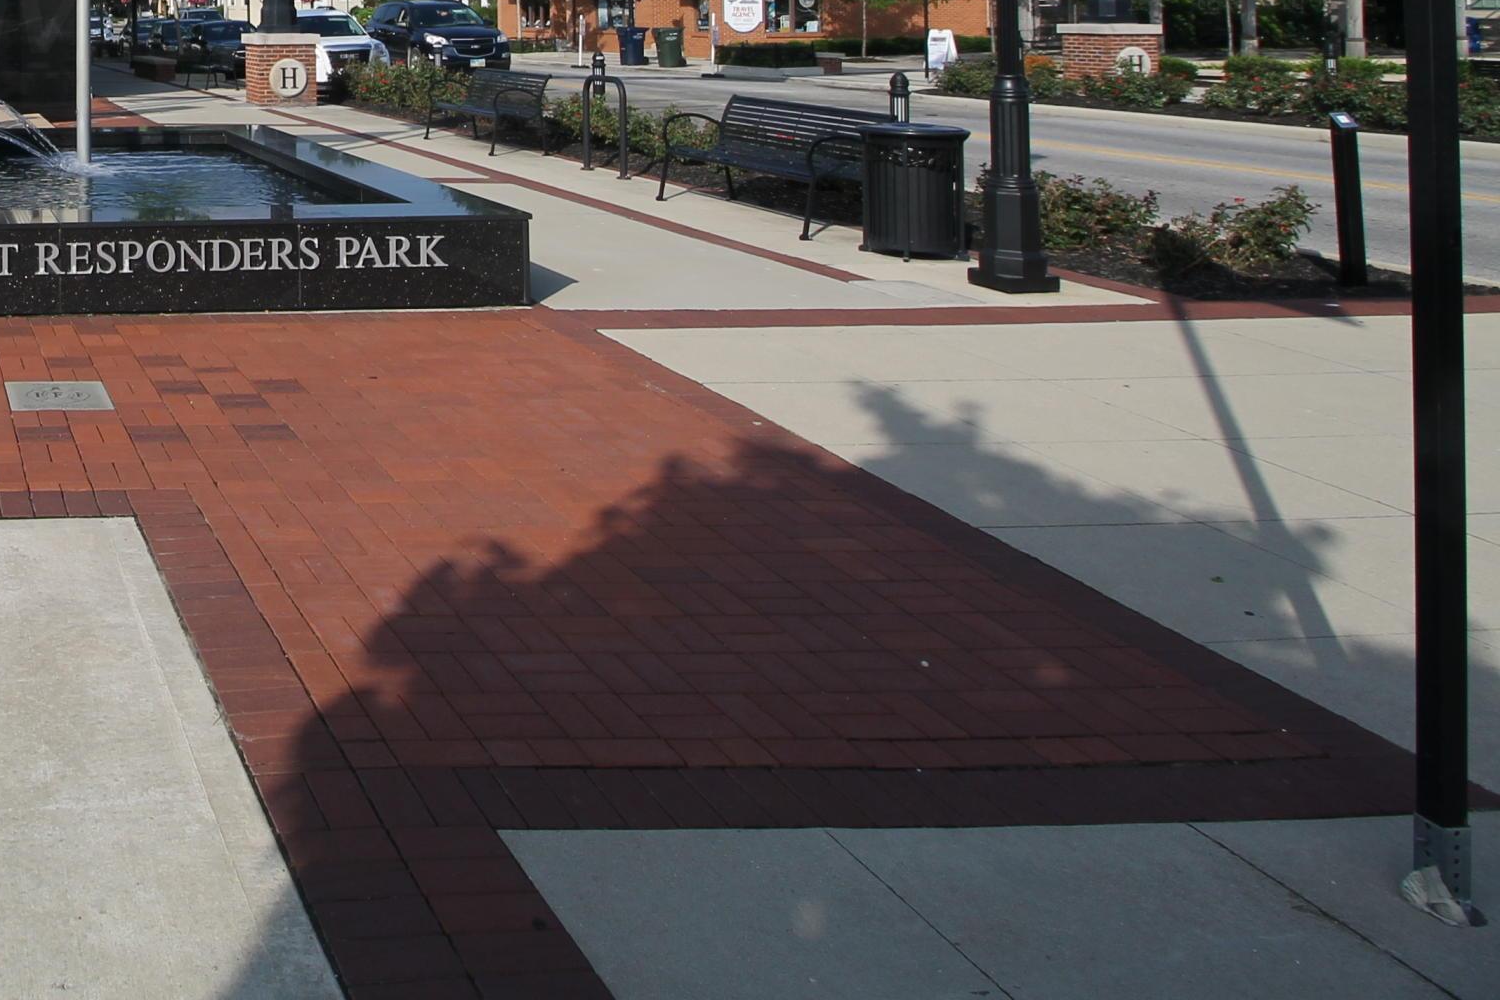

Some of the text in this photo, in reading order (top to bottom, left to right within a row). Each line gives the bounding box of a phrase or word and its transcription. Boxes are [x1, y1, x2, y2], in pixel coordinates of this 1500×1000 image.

[280, 67, 299, 89] H
[34, 236, 320, 277] RESPONDERS
[335, 235, 449, 269] PARK
